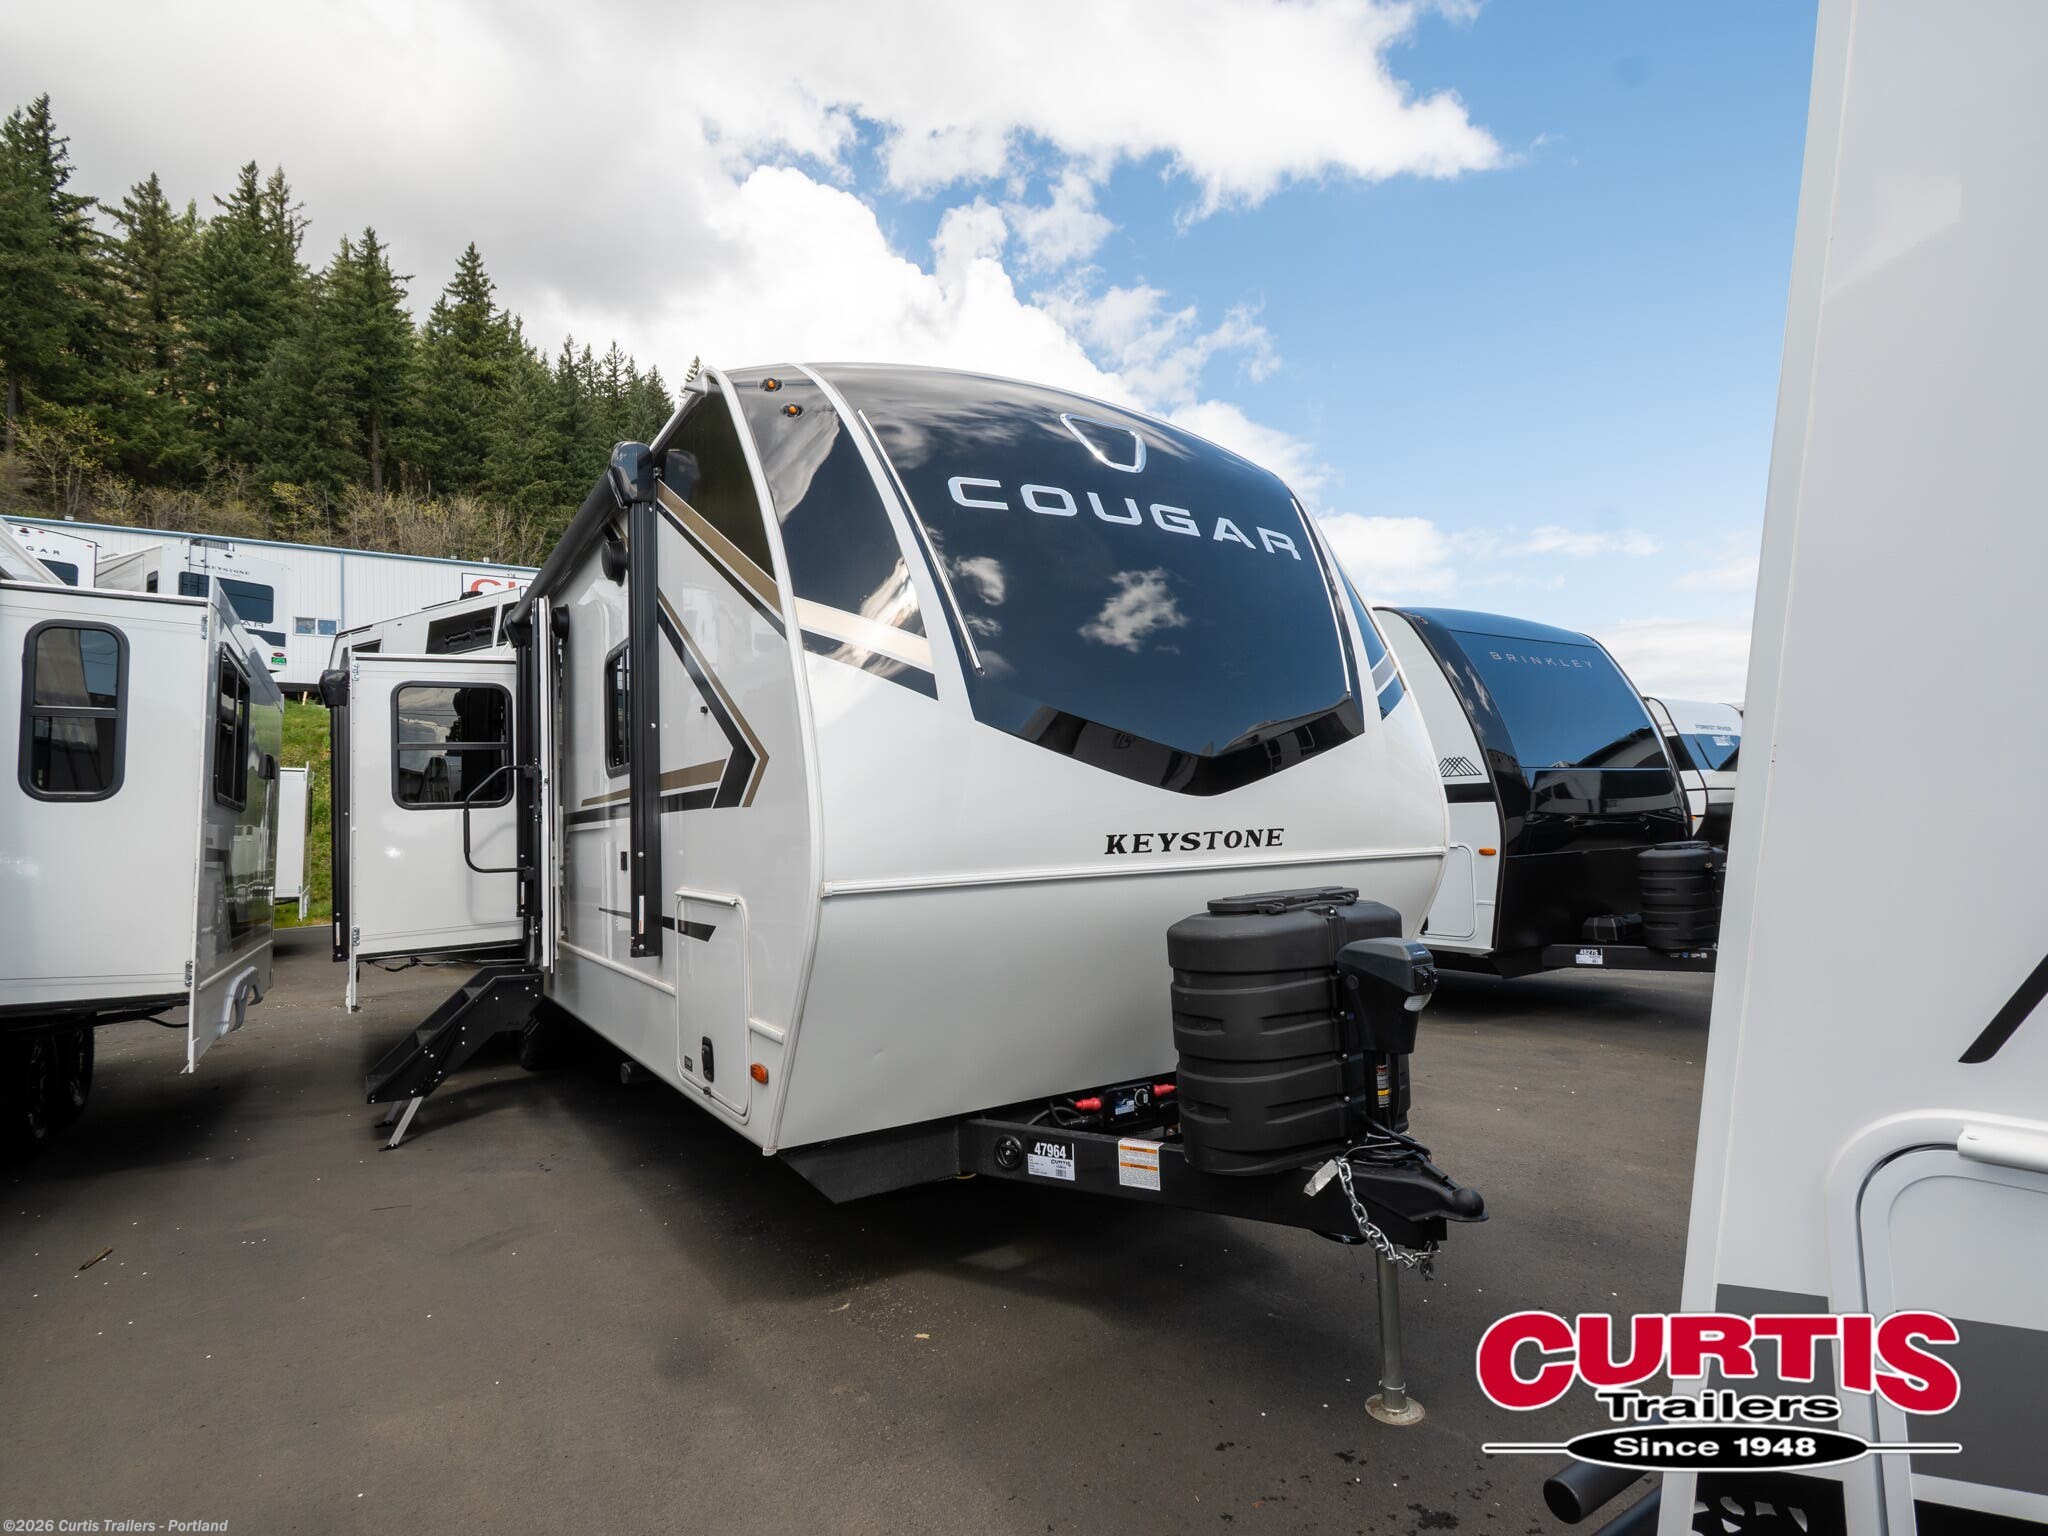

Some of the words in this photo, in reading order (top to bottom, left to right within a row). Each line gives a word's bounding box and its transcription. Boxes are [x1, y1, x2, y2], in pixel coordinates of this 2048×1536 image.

[948, 475, 1303, 561] COUGAR
[1489, 651, 1593, 669] BRINKLEY
[1104, 827, 1285, 855] KEYSTONE
[1034, 1142, 1067, 1159] 47964
